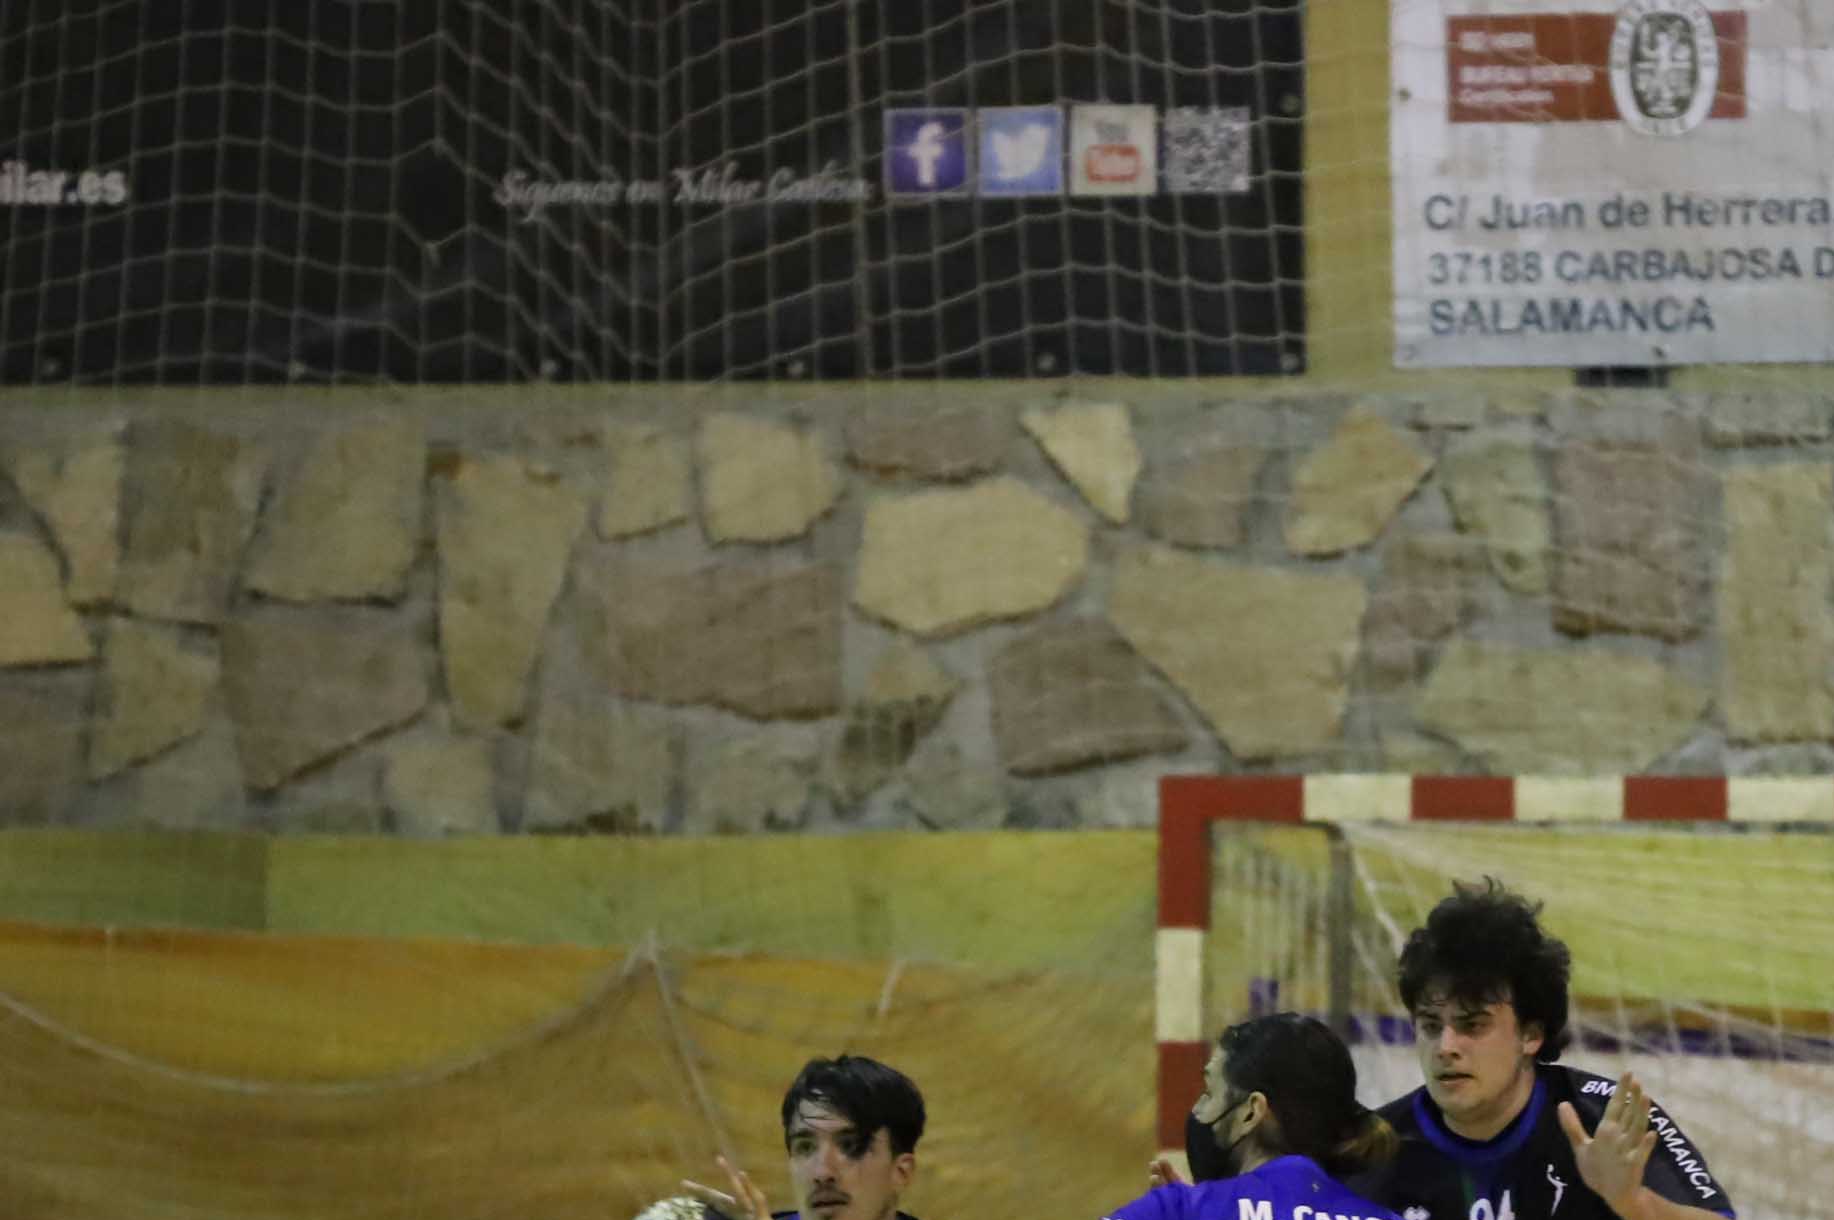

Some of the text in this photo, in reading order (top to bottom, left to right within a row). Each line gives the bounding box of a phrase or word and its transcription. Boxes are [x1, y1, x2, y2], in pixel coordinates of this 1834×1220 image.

[1425, 196, 1466, 231] C/
[1480, 196, 1587, 231] Juan
[1600, 194, 1647, 228] de
[1428, 249, 1543, 284] 37188
[1554, 243, 1800, 283] CARBAJOSA
[1429, 297, 1717, 336] SALAMANCA
